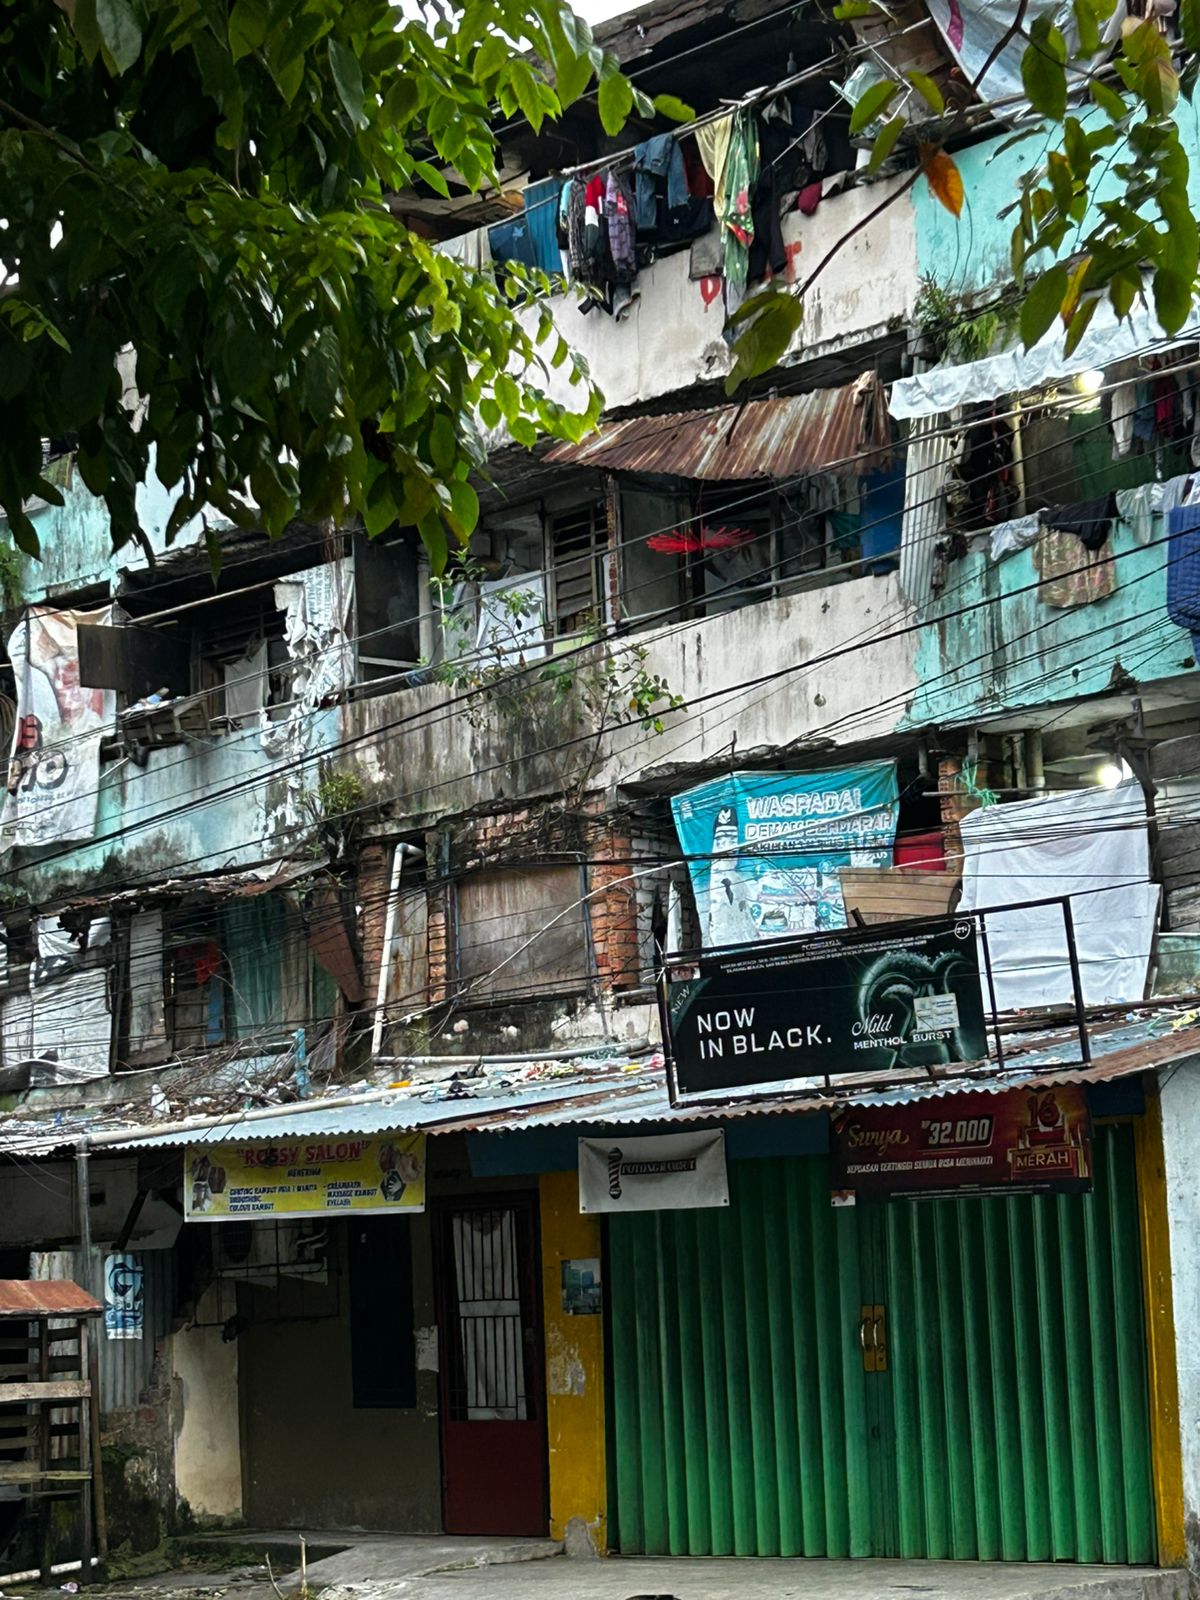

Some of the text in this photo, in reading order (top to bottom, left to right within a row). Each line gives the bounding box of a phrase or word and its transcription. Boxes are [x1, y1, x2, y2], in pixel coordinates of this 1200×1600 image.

[671, 985, 690, 1014] NEW
[697, 1007, 755, 1034] NOW
[851, 1013, 894, 1036] Mild
[700, 1024, 832, 1060] IN BLACK.
[853, 1030, 952, 1050] MENTHOL BURST
[1026, 1092, 1061, 1128] 16
[848, 1124, 910, 1156] Surya
[1016, 1151, 1069, 1167] MERAH
